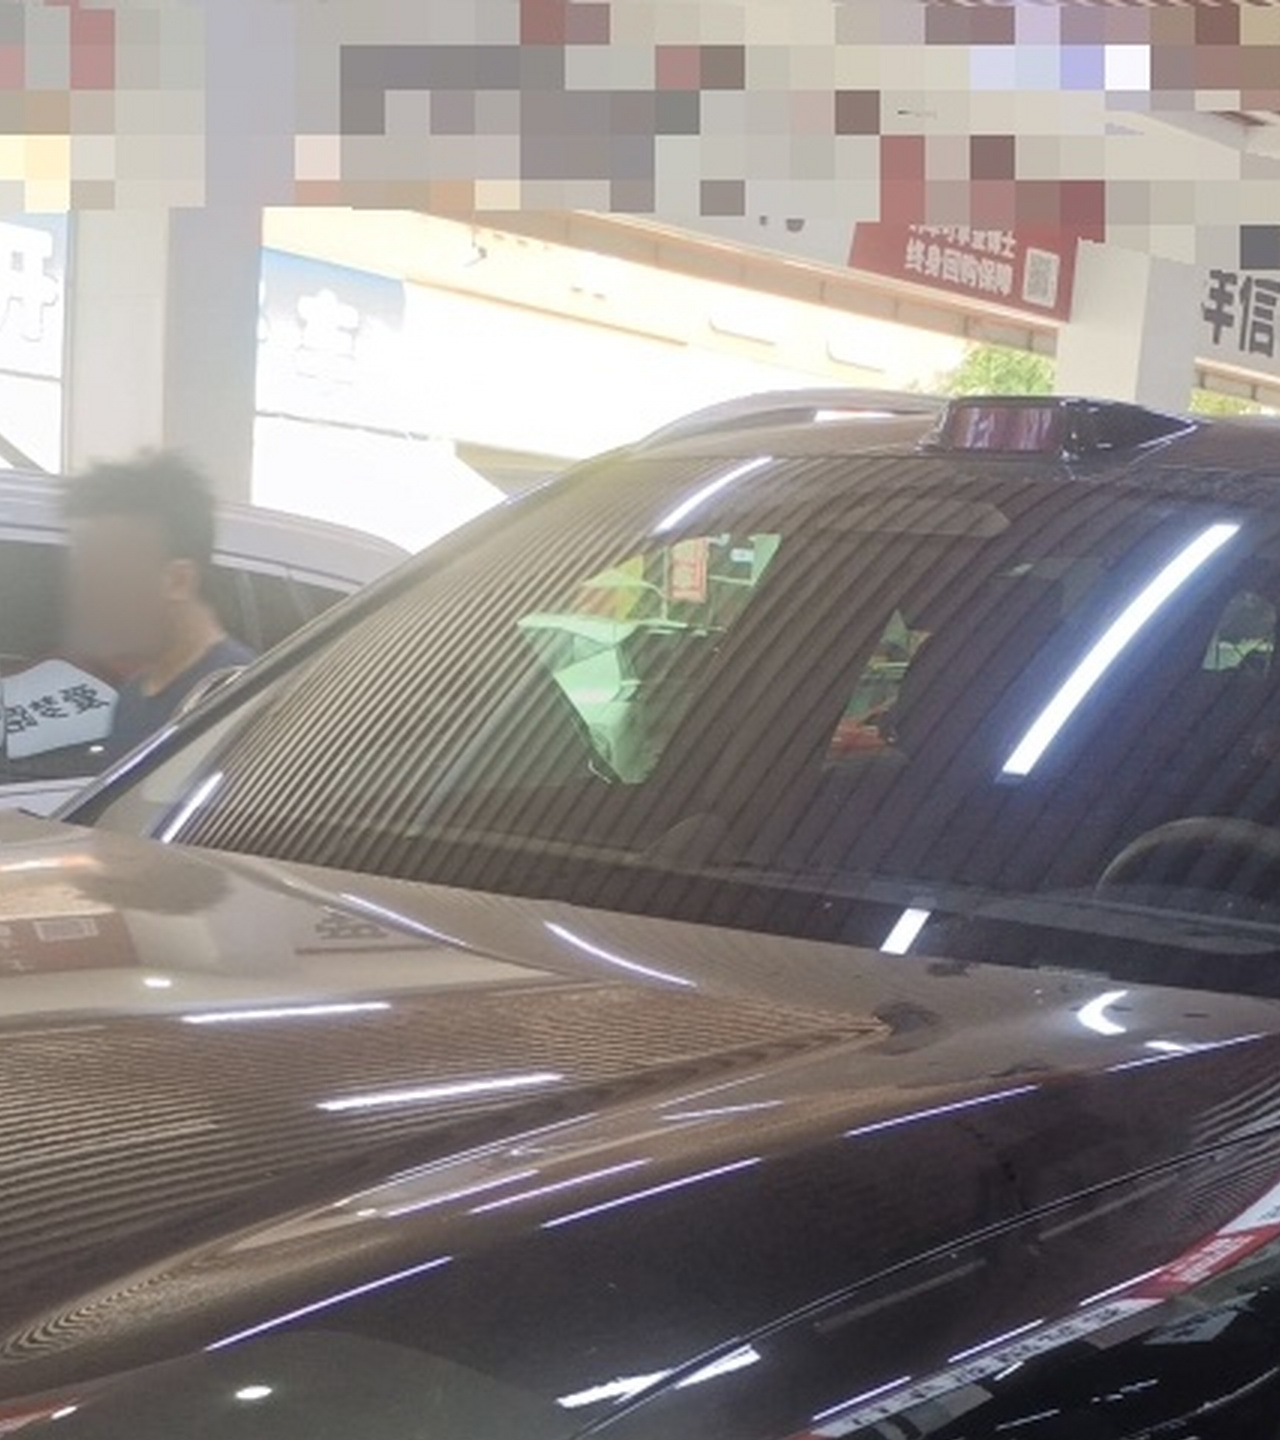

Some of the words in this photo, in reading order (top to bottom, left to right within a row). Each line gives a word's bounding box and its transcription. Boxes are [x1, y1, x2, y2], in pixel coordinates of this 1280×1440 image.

[904, 238, 1014, 297] 终身回购保障
